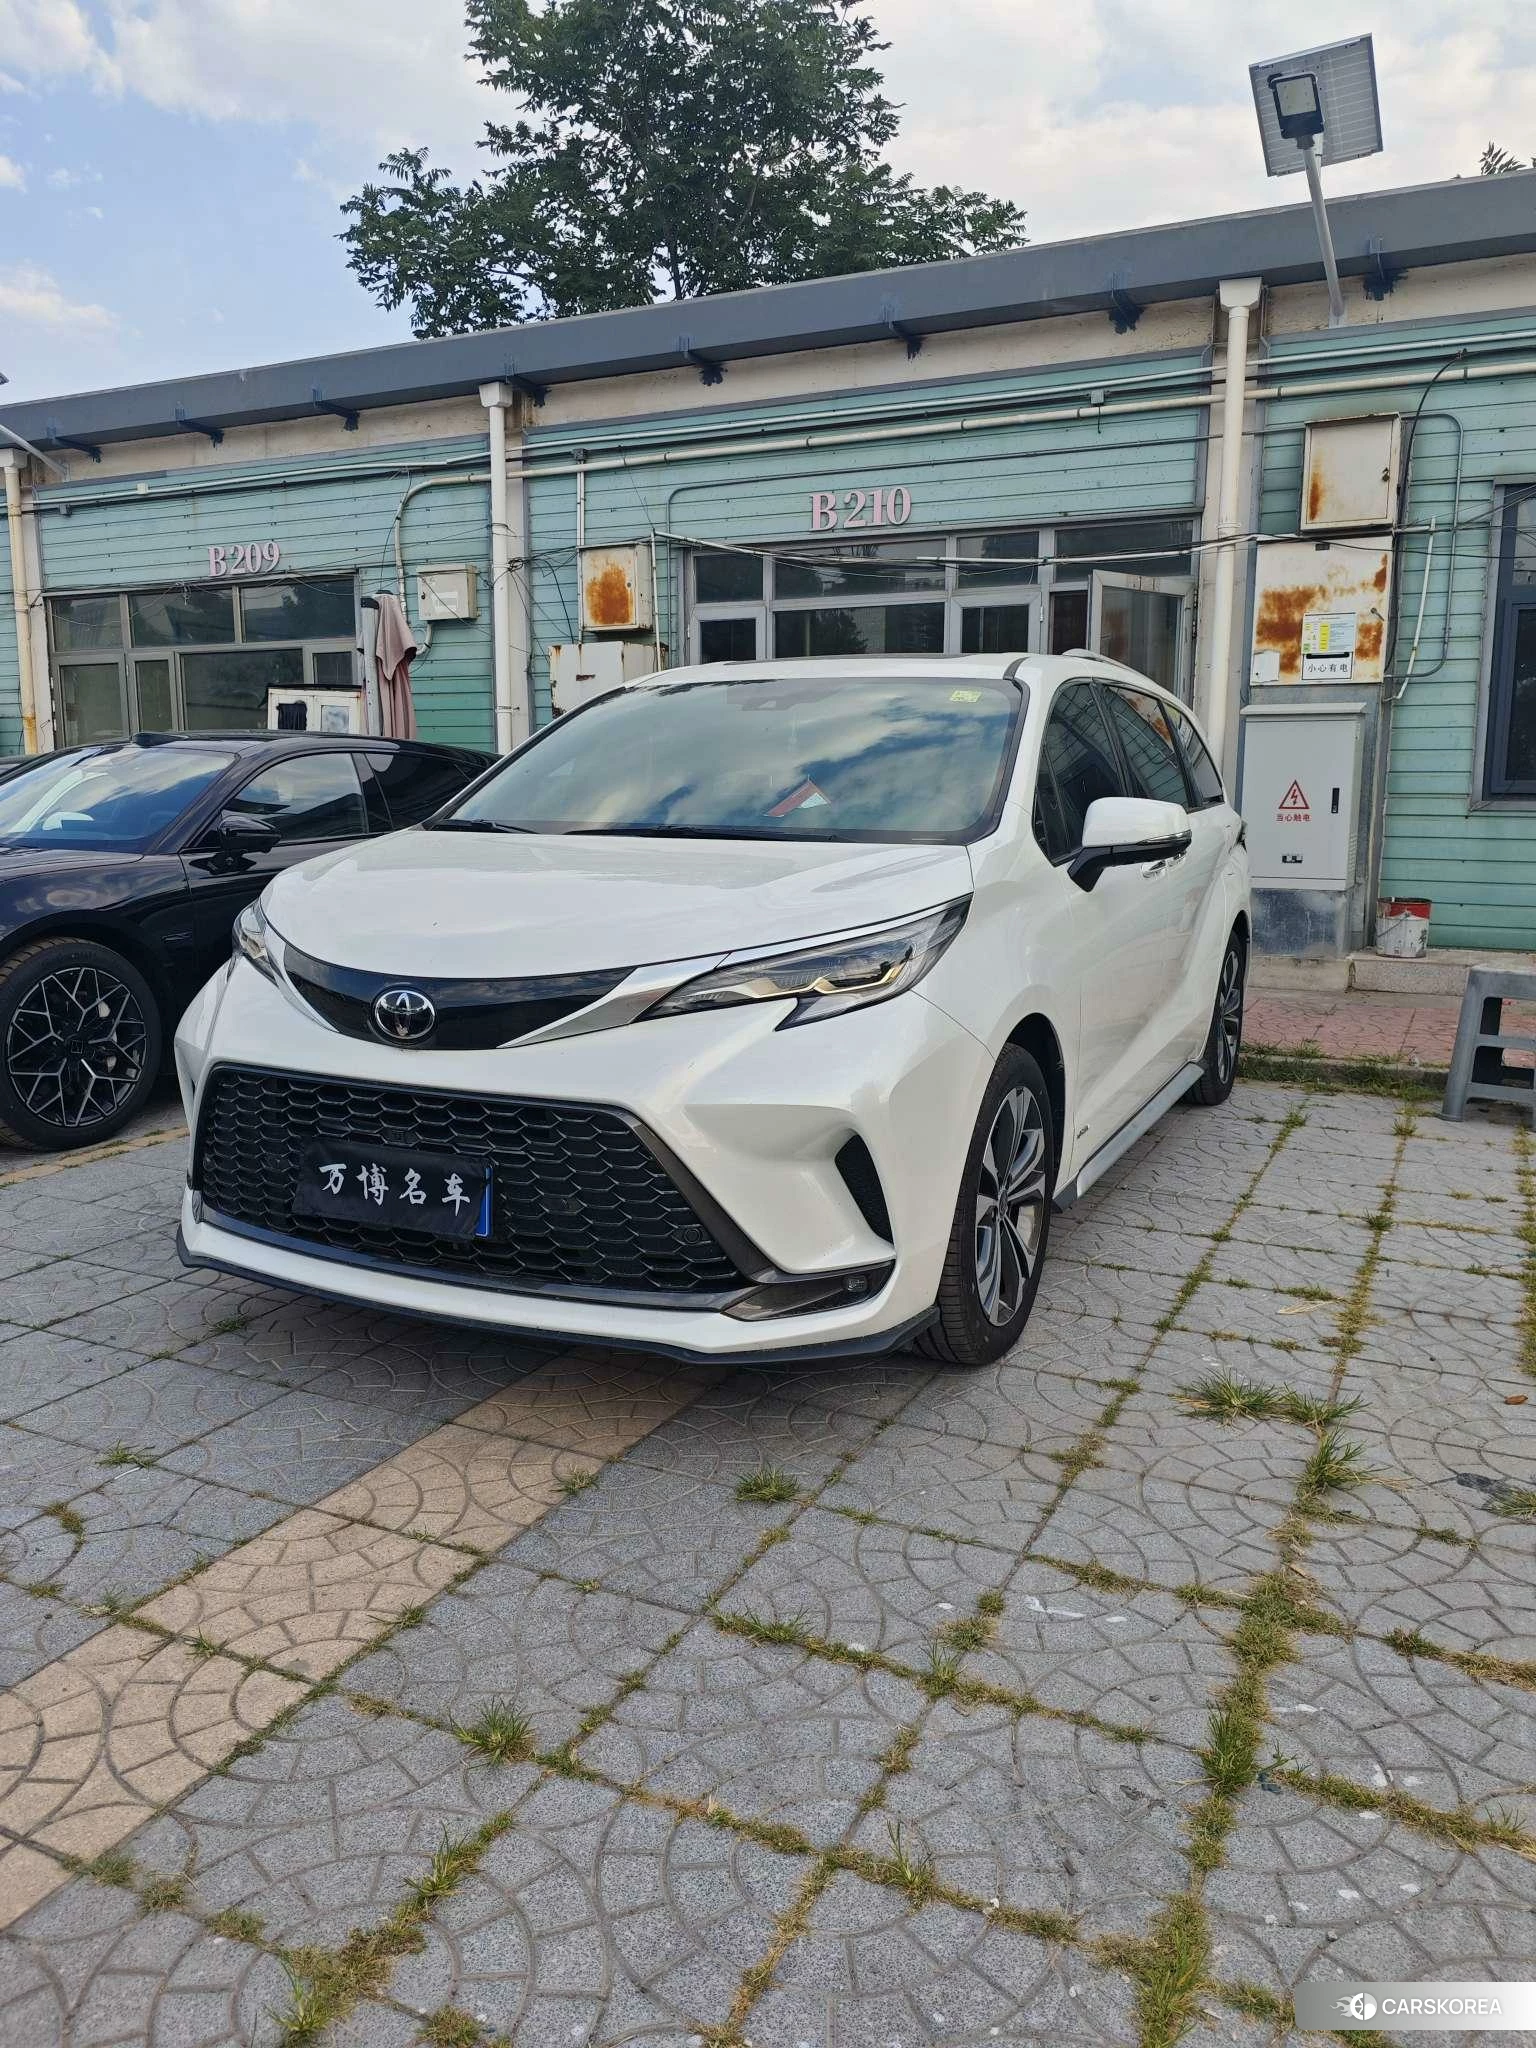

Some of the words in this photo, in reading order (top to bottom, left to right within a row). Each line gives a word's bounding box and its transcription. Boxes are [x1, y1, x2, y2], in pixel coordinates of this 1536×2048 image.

[1307, 663, 1348, 673] 小心有电
[319, 1163, 471, 1217] 万博名车
